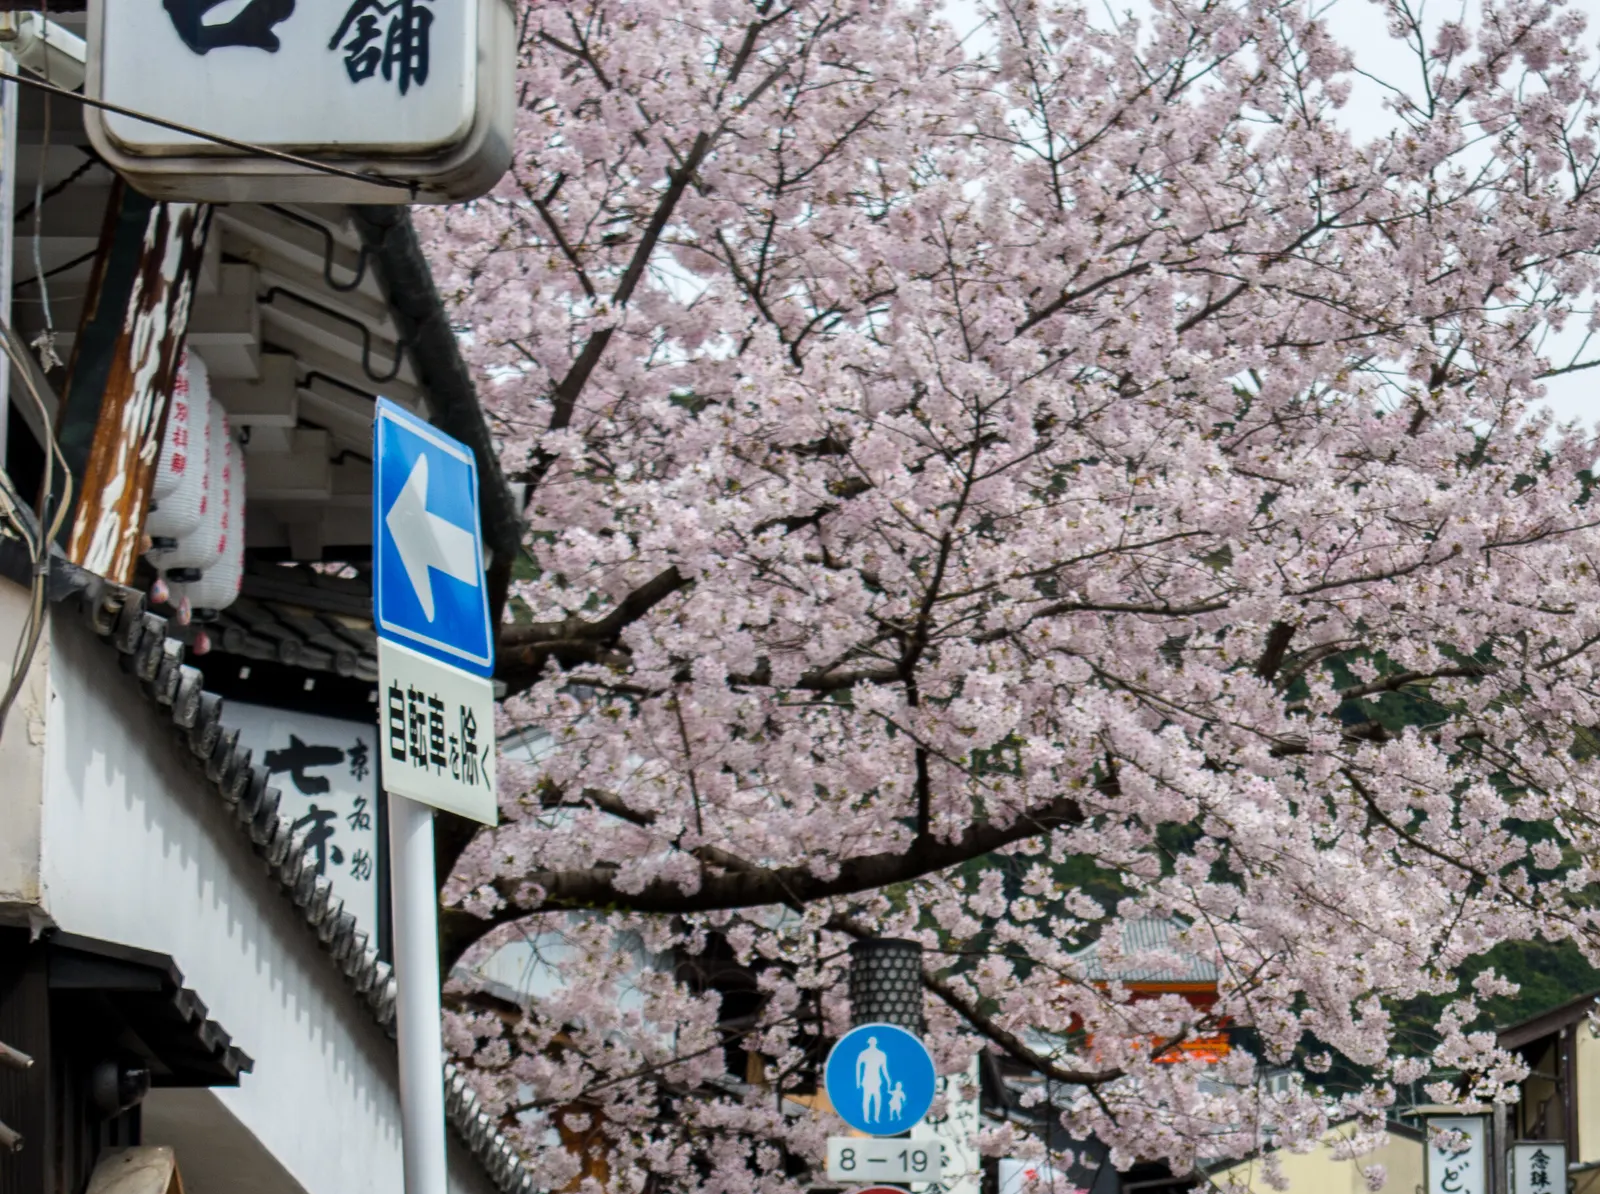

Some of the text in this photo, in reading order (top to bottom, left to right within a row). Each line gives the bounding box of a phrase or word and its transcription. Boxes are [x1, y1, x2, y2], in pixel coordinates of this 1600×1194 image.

[388, 679, 492, 792] 自転車を除く
[347, 738, 374, 882] 京名物
